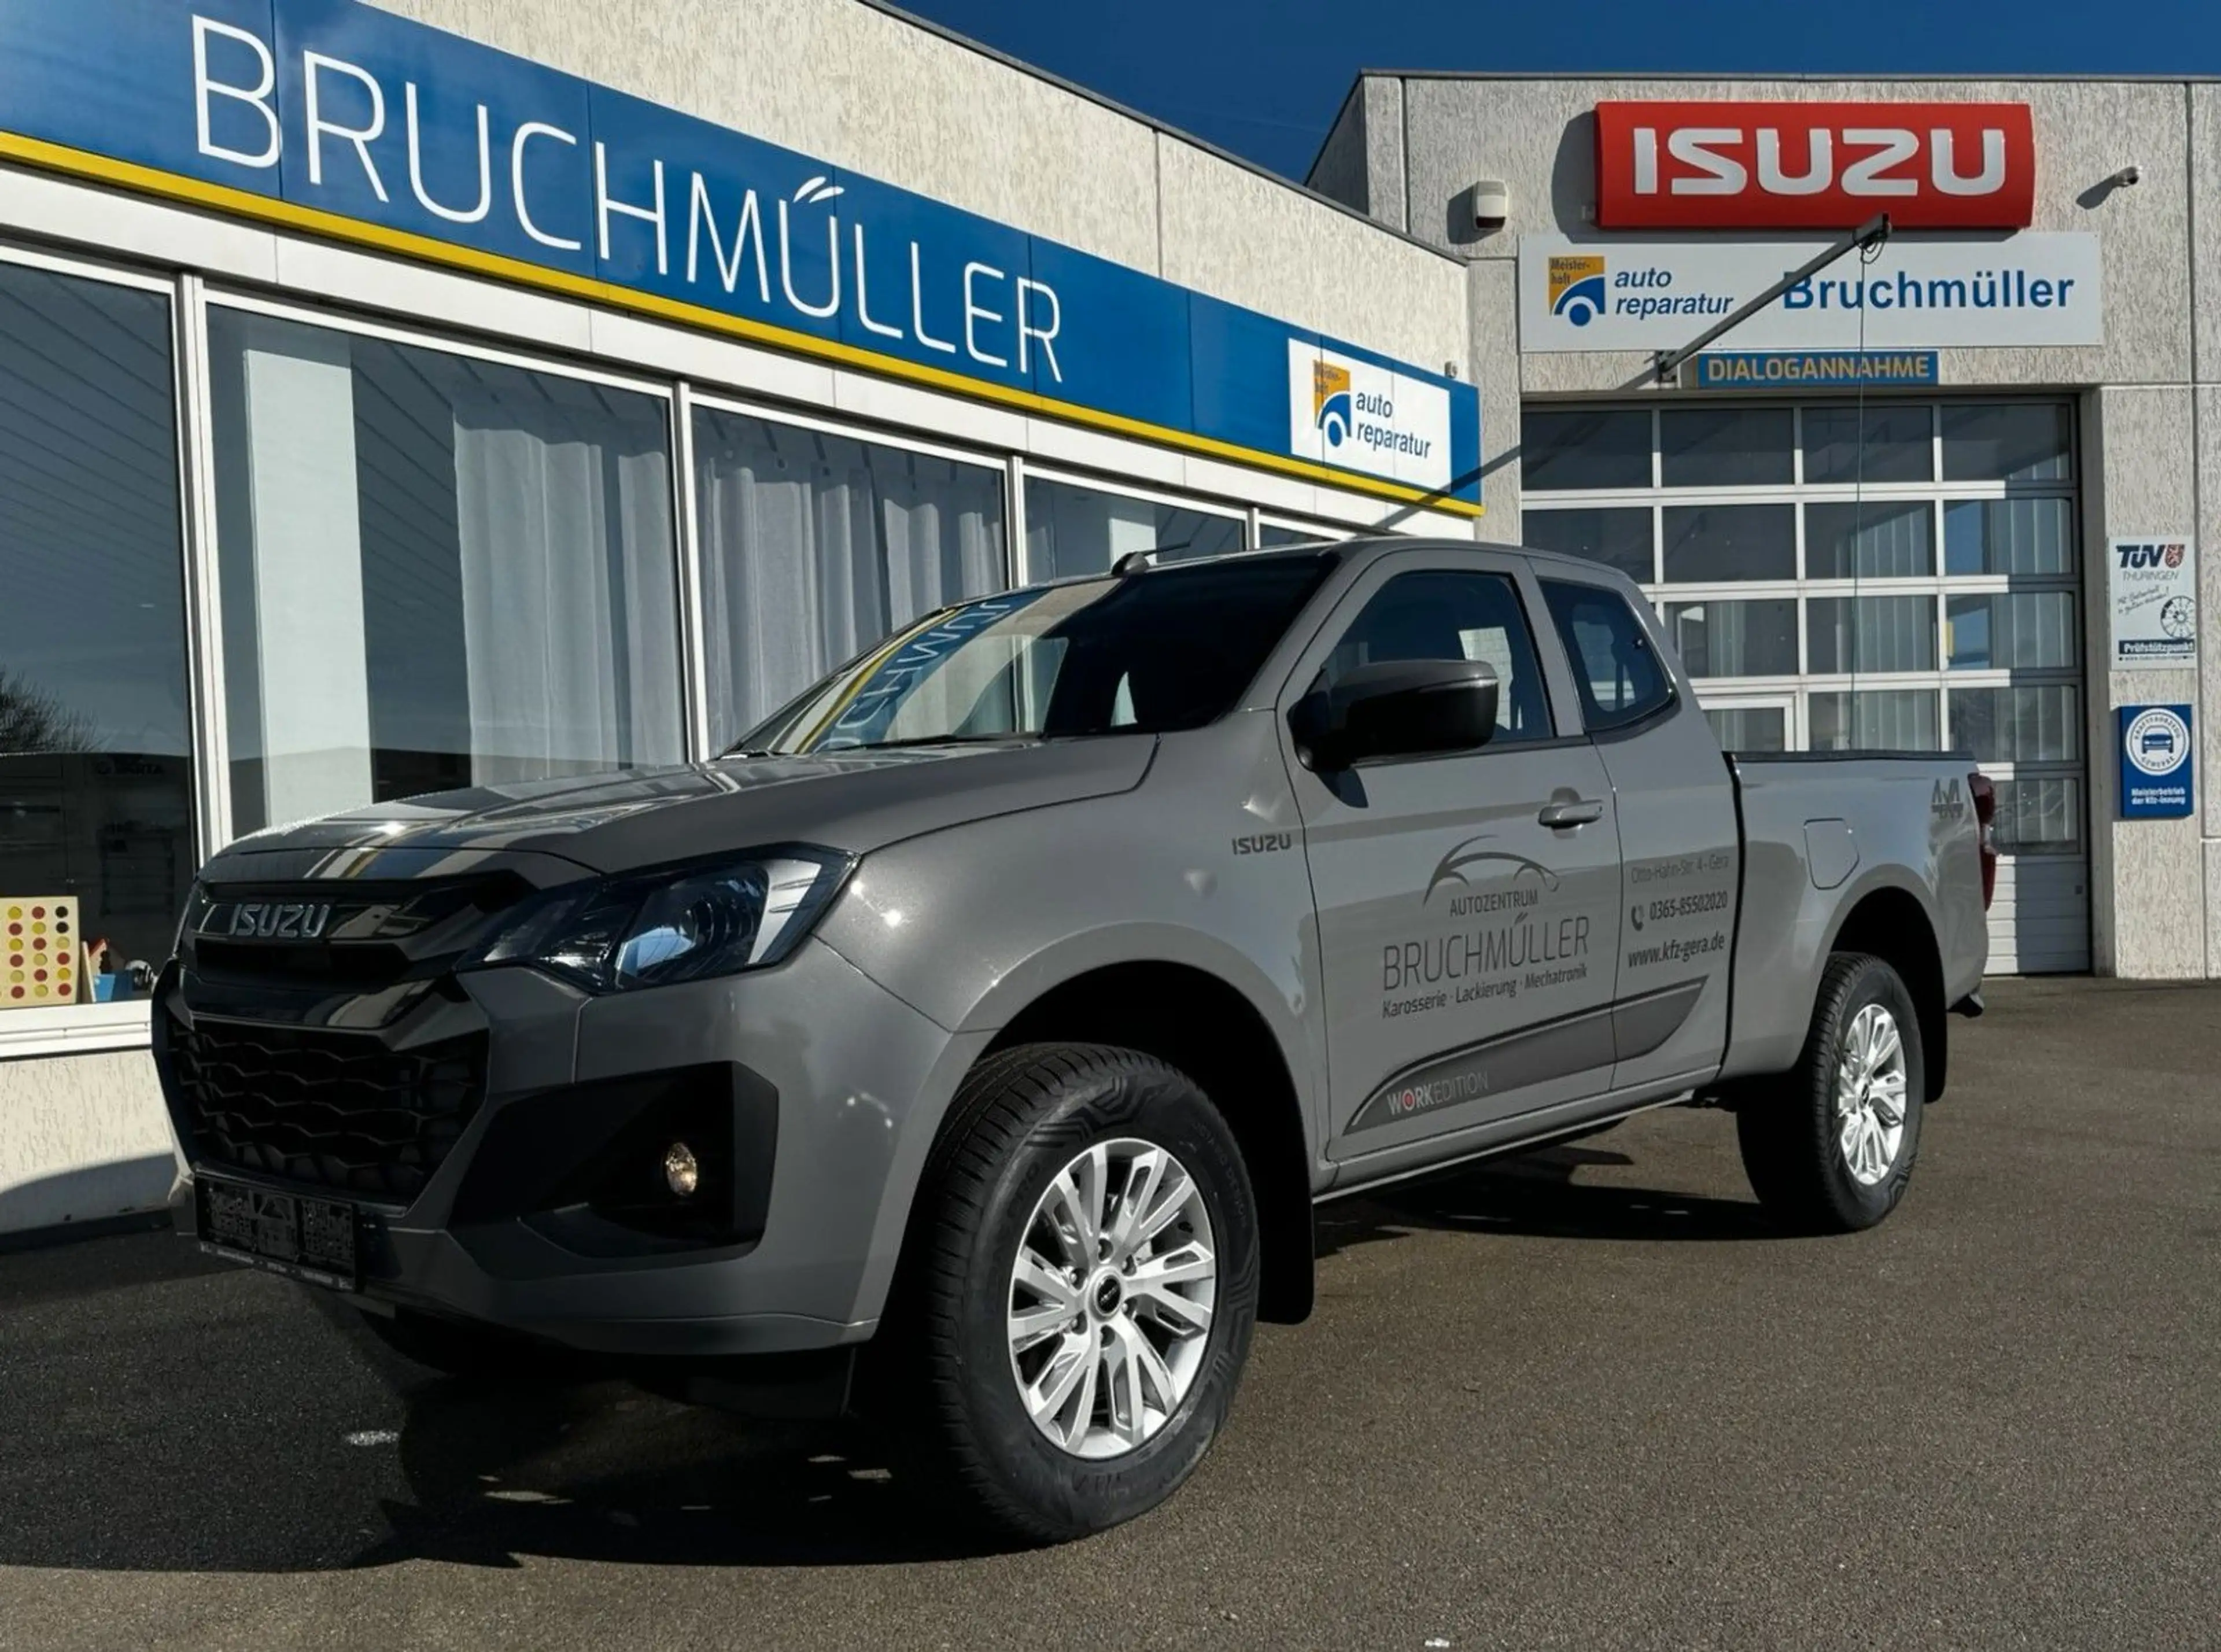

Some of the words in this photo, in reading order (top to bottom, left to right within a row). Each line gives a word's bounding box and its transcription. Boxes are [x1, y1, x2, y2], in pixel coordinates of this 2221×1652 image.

[1634, 128, 2006, 196] ISUZU
[192, 14, 1062, 383] BRUCHMÜLLER
[1614, 267, 1672, 287] auto
[1783, 270, 2075, 309] Bruchmüller
[1615, 293, 1734, 320] reparatur
[1707, 356, 1931, 381] DIALOGANNAHME
[1356, 392, 1393, 418] auto
[1357, 422, 1432, 459] reparatur
[1231, 832, 1292, 856] ISUZU
[230, 903, 330, 938] ISUZU
[1449, 889, 1539, 917] AUTOZENTRUM
[1383, 912, 1590, 991] BRUCHMÜLLER
[1628, 930, 1725, 968] www.kfz-gera.de
[1382, 990, 1447, 1019] Karosserie
[1455, 978, 1517, 1004] Lackierung
[1523, 963, 1588, 990] Mechatronik
